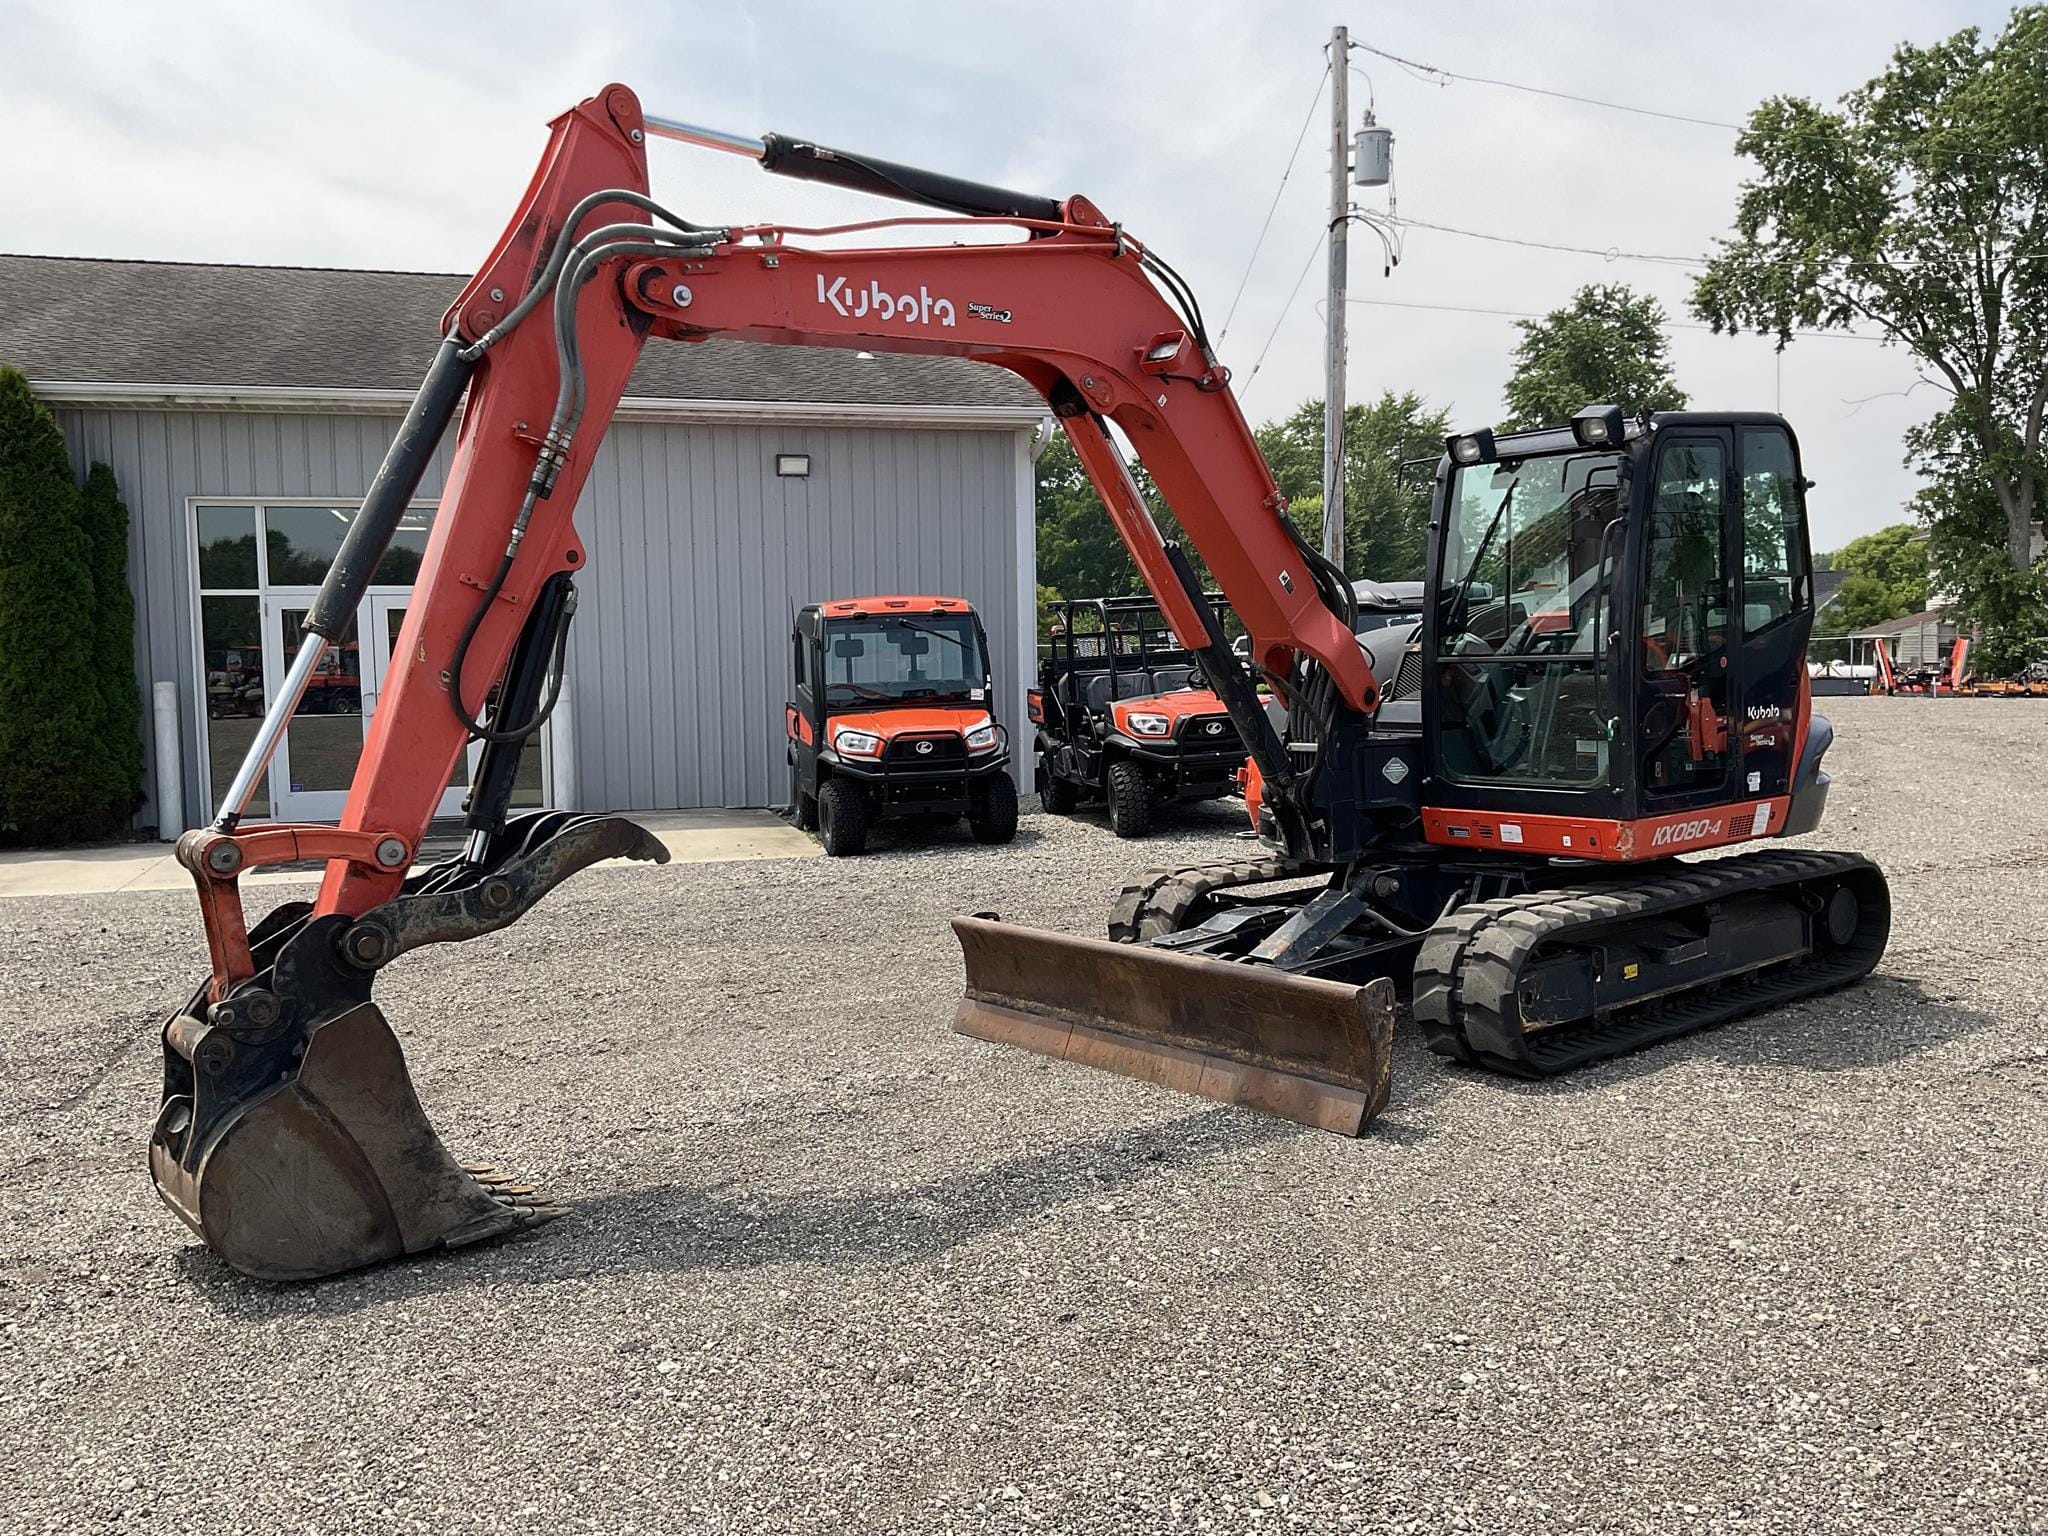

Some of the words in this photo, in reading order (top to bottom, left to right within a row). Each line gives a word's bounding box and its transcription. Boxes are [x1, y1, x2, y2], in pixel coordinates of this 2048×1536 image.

[817, 274, 956, 327] Kubota
[968, 302, 992, 313] Super
[1747, 703, 1780, 720] Kubota
[1651, 820, 1722, 846] KX080-4
